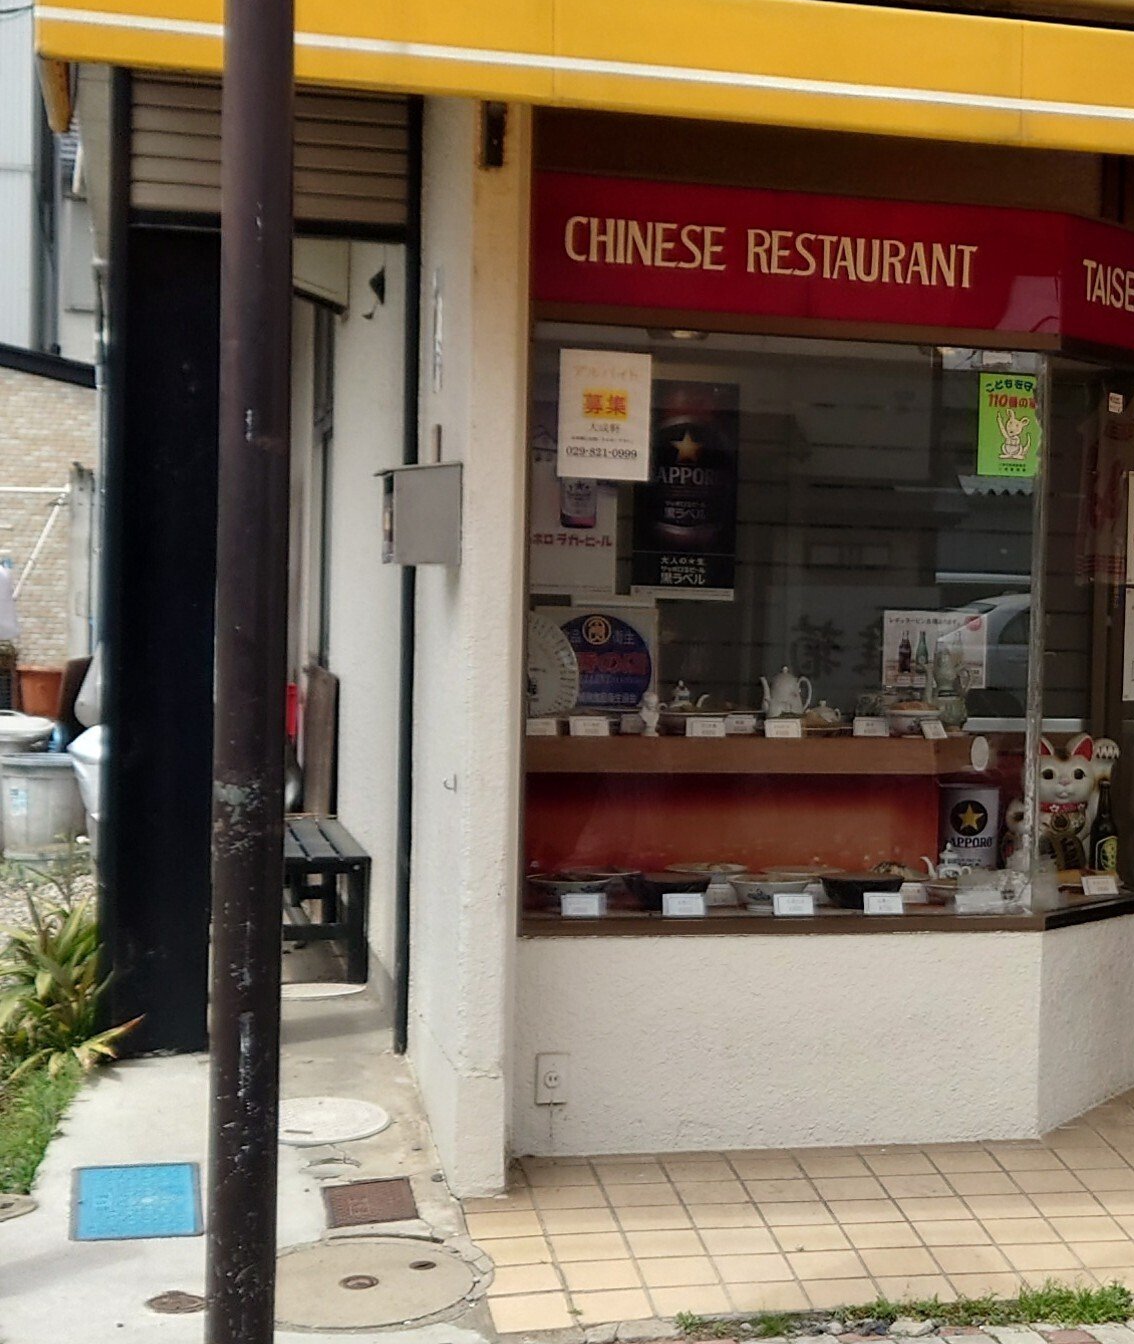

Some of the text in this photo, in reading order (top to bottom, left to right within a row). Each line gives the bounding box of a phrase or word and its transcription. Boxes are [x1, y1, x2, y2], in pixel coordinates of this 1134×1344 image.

[564, 215, 978, 288] CHINESE RESTAURANT
[583, 392, 627, 415] 募集
[660, 573, 706, 585] 黒ラベル
[945, 836, 994, 848] APPORO
